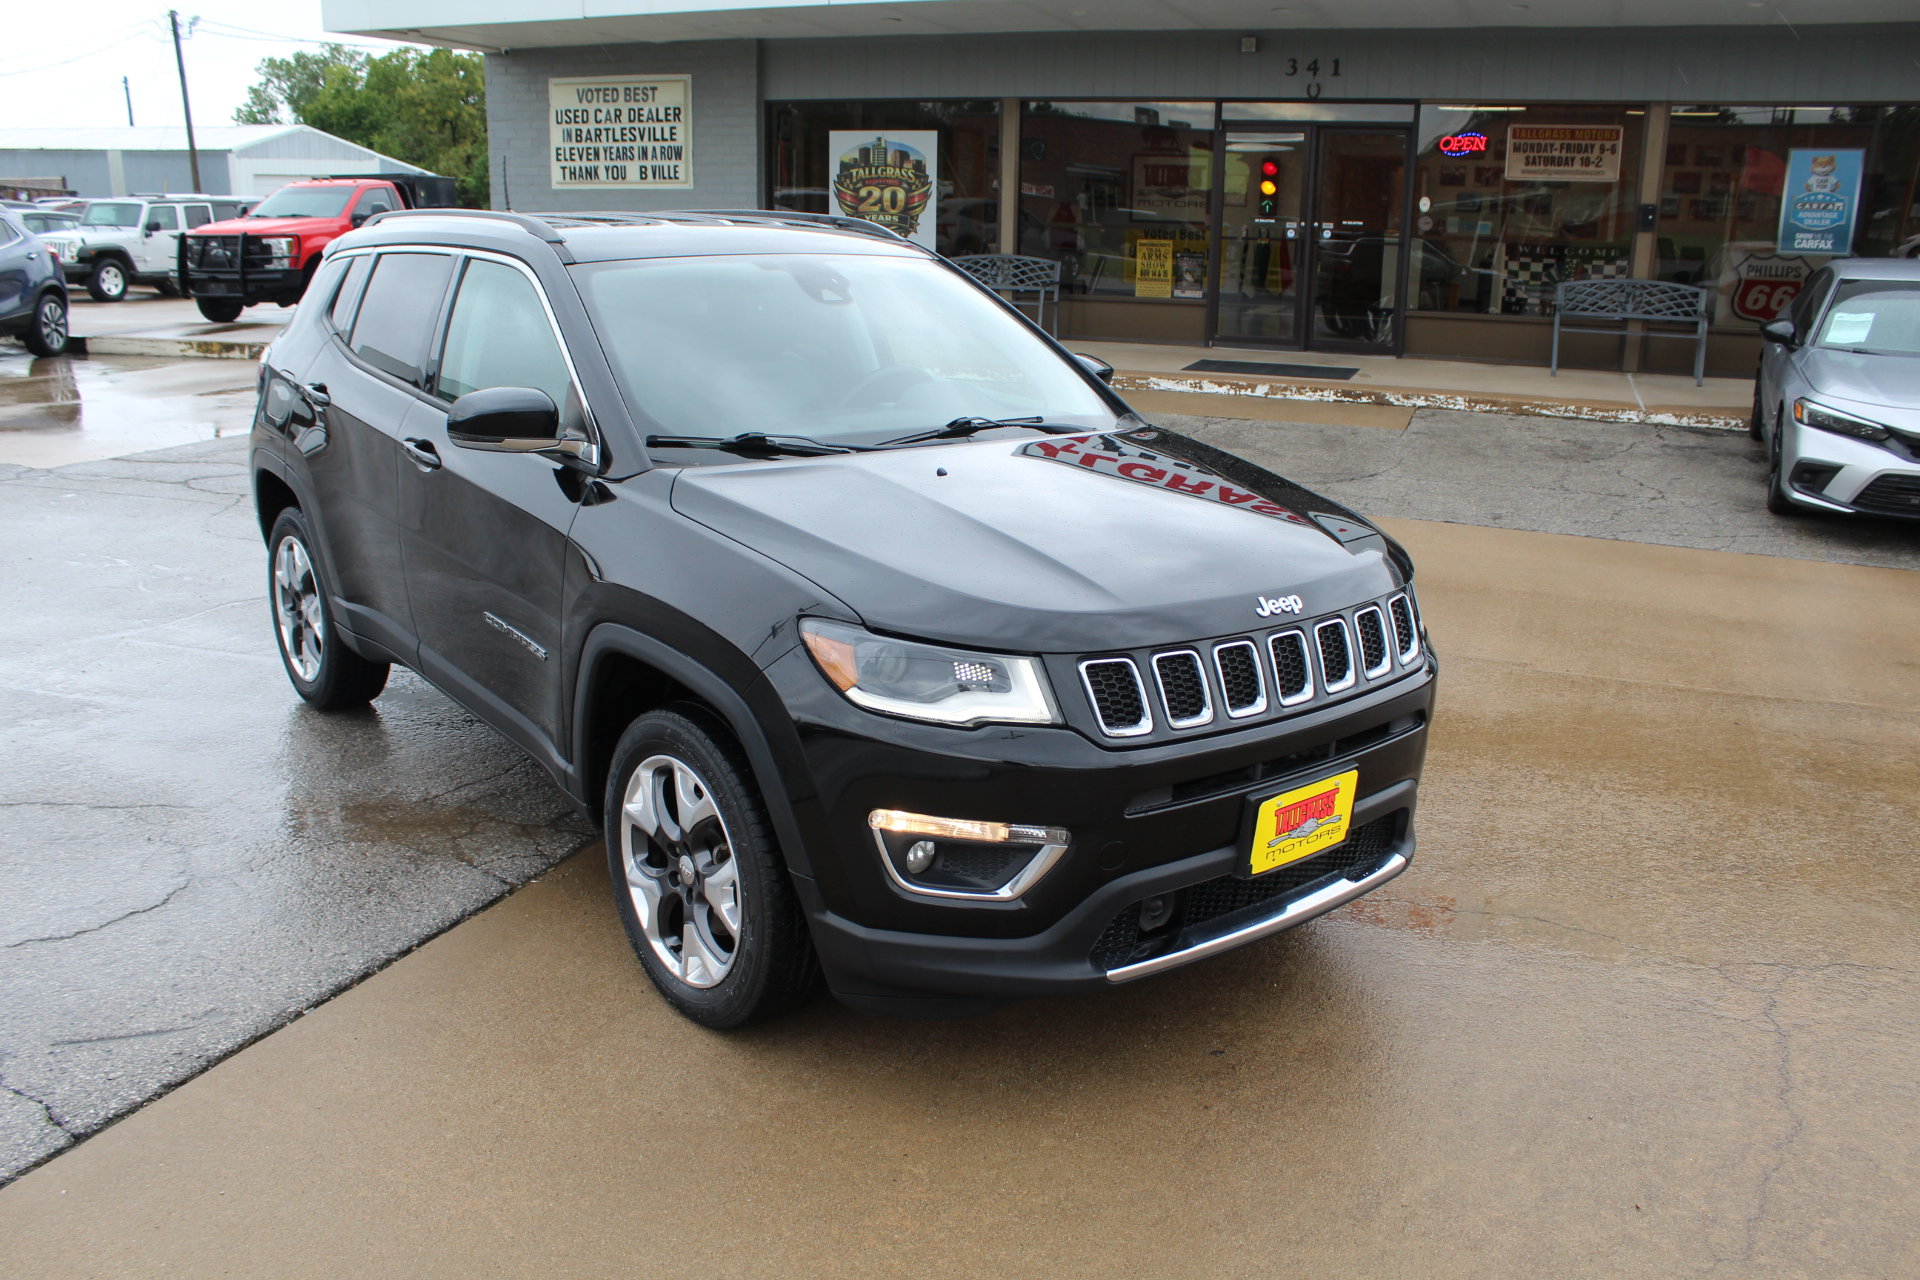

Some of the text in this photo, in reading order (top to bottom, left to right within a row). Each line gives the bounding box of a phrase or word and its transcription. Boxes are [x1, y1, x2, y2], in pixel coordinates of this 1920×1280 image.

[1285, 58, 1341, 77] 341
[576, 86, 658, 103] VOTED BEST
[555, 107, 682, 124] USED CAR DEALER
[1515, 128, 1617, 140] TALLGRASS MOTORS
[1439, 135, 1488, 152] OPEN
[555, 145, 683, 162] ELEVEN YEARS IN A ROW
[1524, 155, 1603, 167] SATURDAY 10-2
[560, 166, 600, 181] THANK
[604, 165, 627, 180] YOU
[850, 166, 916, 184] TALLGRASS
[858, 186, 906, 214] 20
[864, 214, 899, 222] YEARS
[1794, 239, 1834, 250] CARFAX
[1141, 252, 1168, 261] ARMS
[1141, 261, 1167, 269] SHOW
[1746, 265, 1802, 279] PHILLIPS
[1745, 285, 1796, 311] 66
[1255, 594, 1303, 618] Jeep
[1275, 787, 1340, 836] TALLGRASS
[1266, 825, 1342, 860] MOTORS
